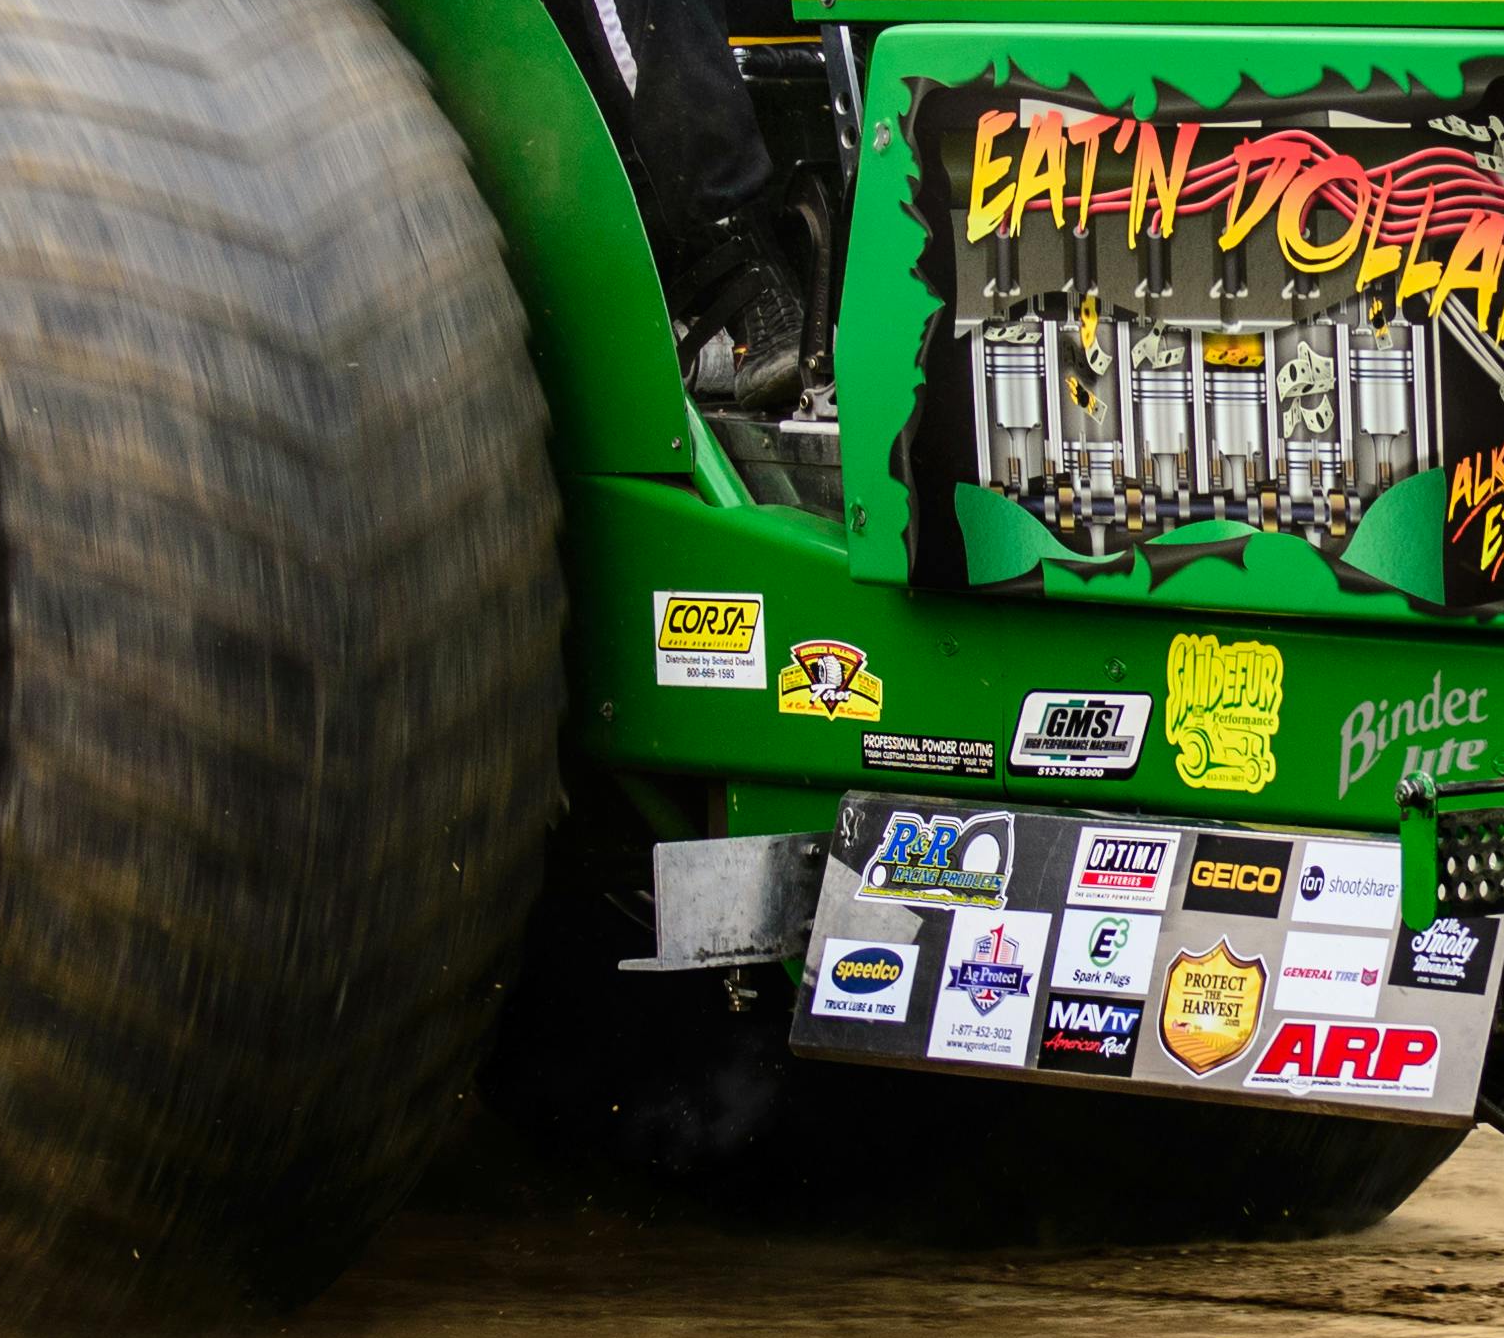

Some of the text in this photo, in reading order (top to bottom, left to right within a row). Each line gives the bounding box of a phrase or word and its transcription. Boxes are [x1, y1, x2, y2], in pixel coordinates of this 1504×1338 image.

[965, 110, 1201, 250] EAT'N
[668, 605, 752, 637] CORSA
[1170, 641, 1278, 732] SANDEFUR
[1047, 707, 1114, 739] GMS
[1211, 711, 1274, 727] Performance
[863, 734, 994, 757] PROFESSIONAL POWDER COATING
[1043, 738, 1088, 751] PERFORMANCE
[1339, 669, 1489, 801] Binder
[1037, 767, 1104, 778] 513-756-9900
[878, 821, 961, 868] R&R
[1089, 842, 1166, 872] OPTIMA
[892, 866, 1006, 891] RACING PRODUCTS
[1097, 874, 1142, 888] BATTERIES
[1192, 861, 1282, 894] GEICO
[1301, 867, 1396, 898] ion shoot/share
[1411, 927, 1479, 964] Smoky
[835, 959, 900, 982] speedco
[980, 968, 1017, 984] Protect
[1072, 969, 1131, 987] Spark Plugs
[1184, 972, 1247, 992] PROTECT
[1283, 967, 1360, 982] GENERAL TIRE
[824, 999, 896, 1015] TRUCK LUBE & TIRES
[1204, 990, 1221, 1001] THE
[1049, 1001, 1139, 1033] MAVTV
[1182, 999, 1243, 1018] HARVEST
[951, 1024, 1013, 1041] 1-877-452-3012
[1224, 1017, 1241, 1028] .com
[1044, 1032, 1131, 1058] American Real
[1254, 1023, 1438, 1082] ARP
[1311, 1079, 1342, 1087] products
